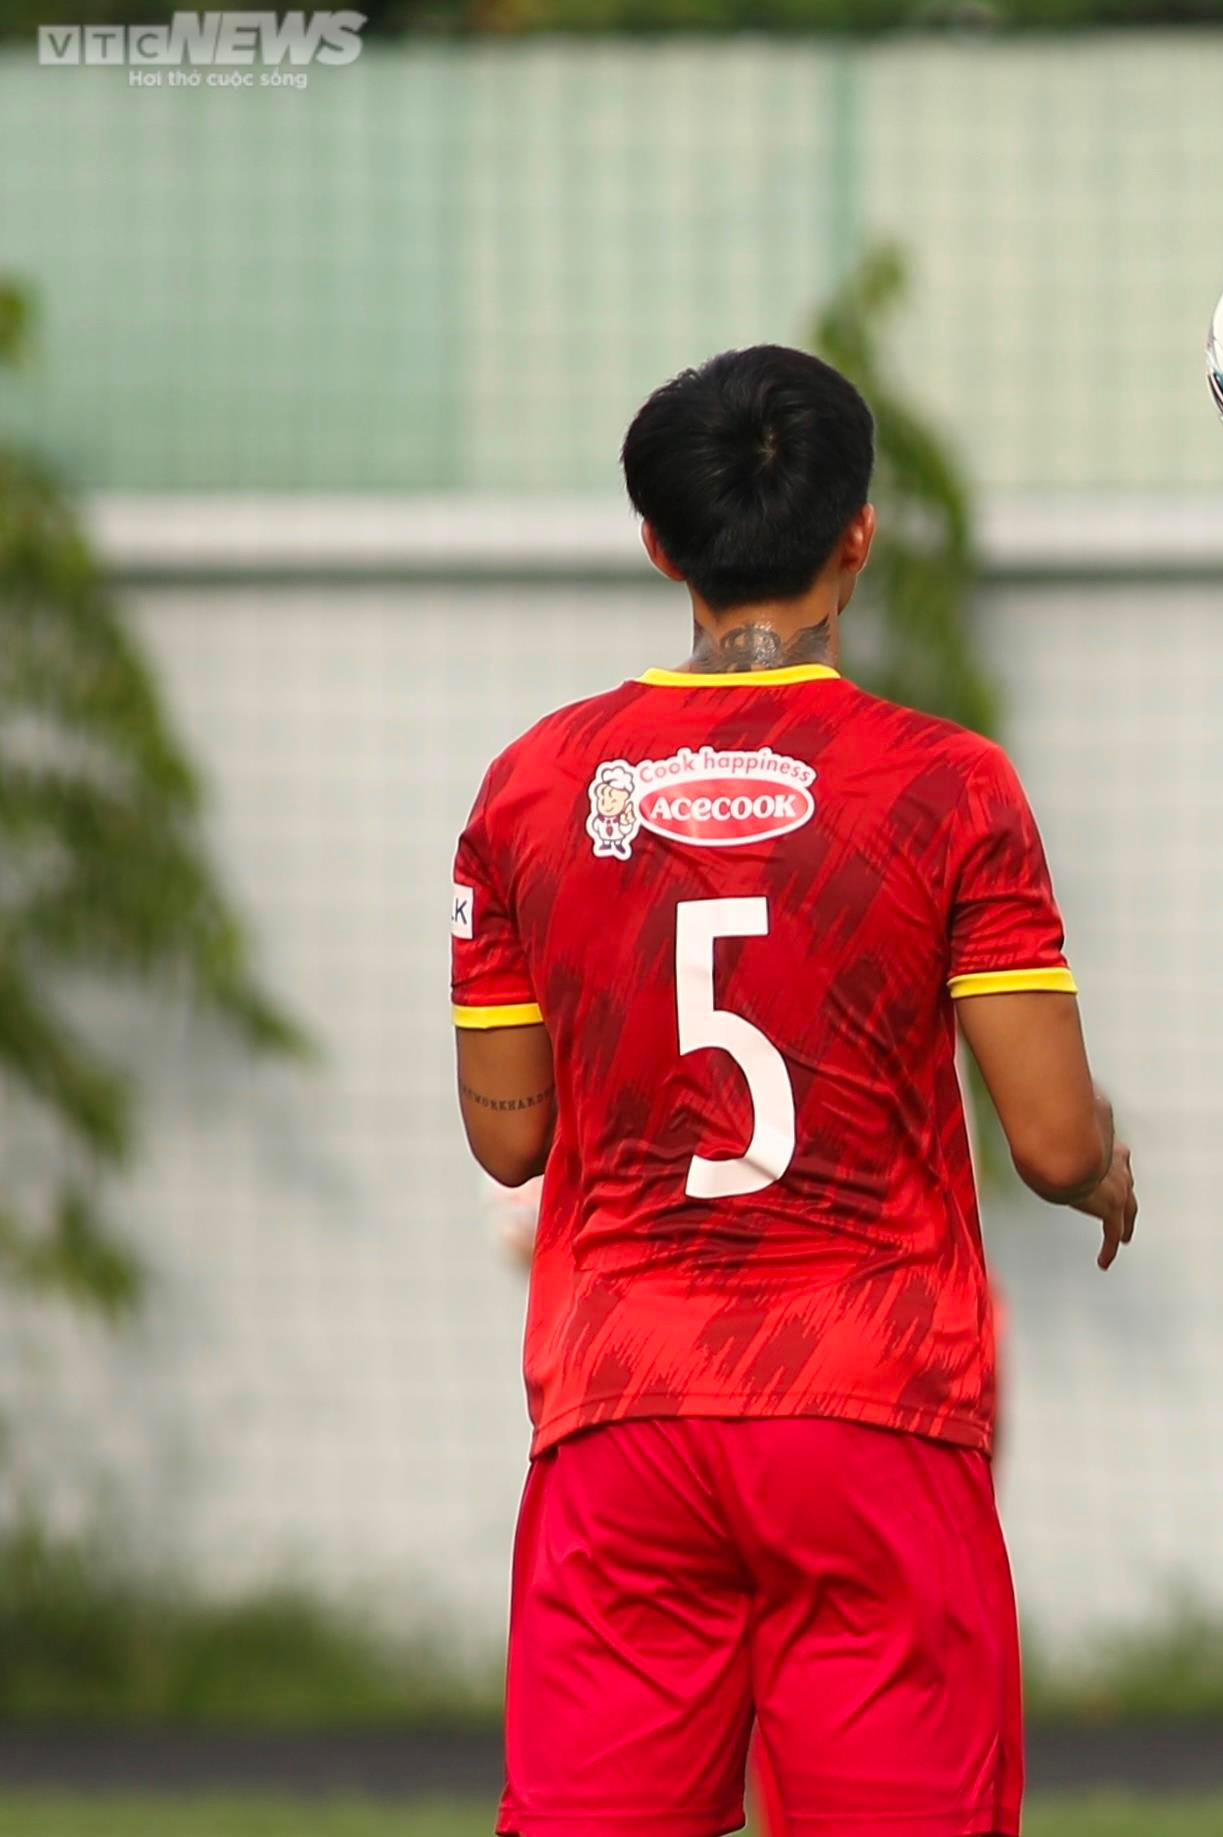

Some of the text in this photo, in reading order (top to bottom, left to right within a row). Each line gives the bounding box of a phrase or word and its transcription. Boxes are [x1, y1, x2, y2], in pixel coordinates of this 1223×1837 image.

[639, 751, 811, 783] Cook happiness
[675, 896, 797, 1199] 5
